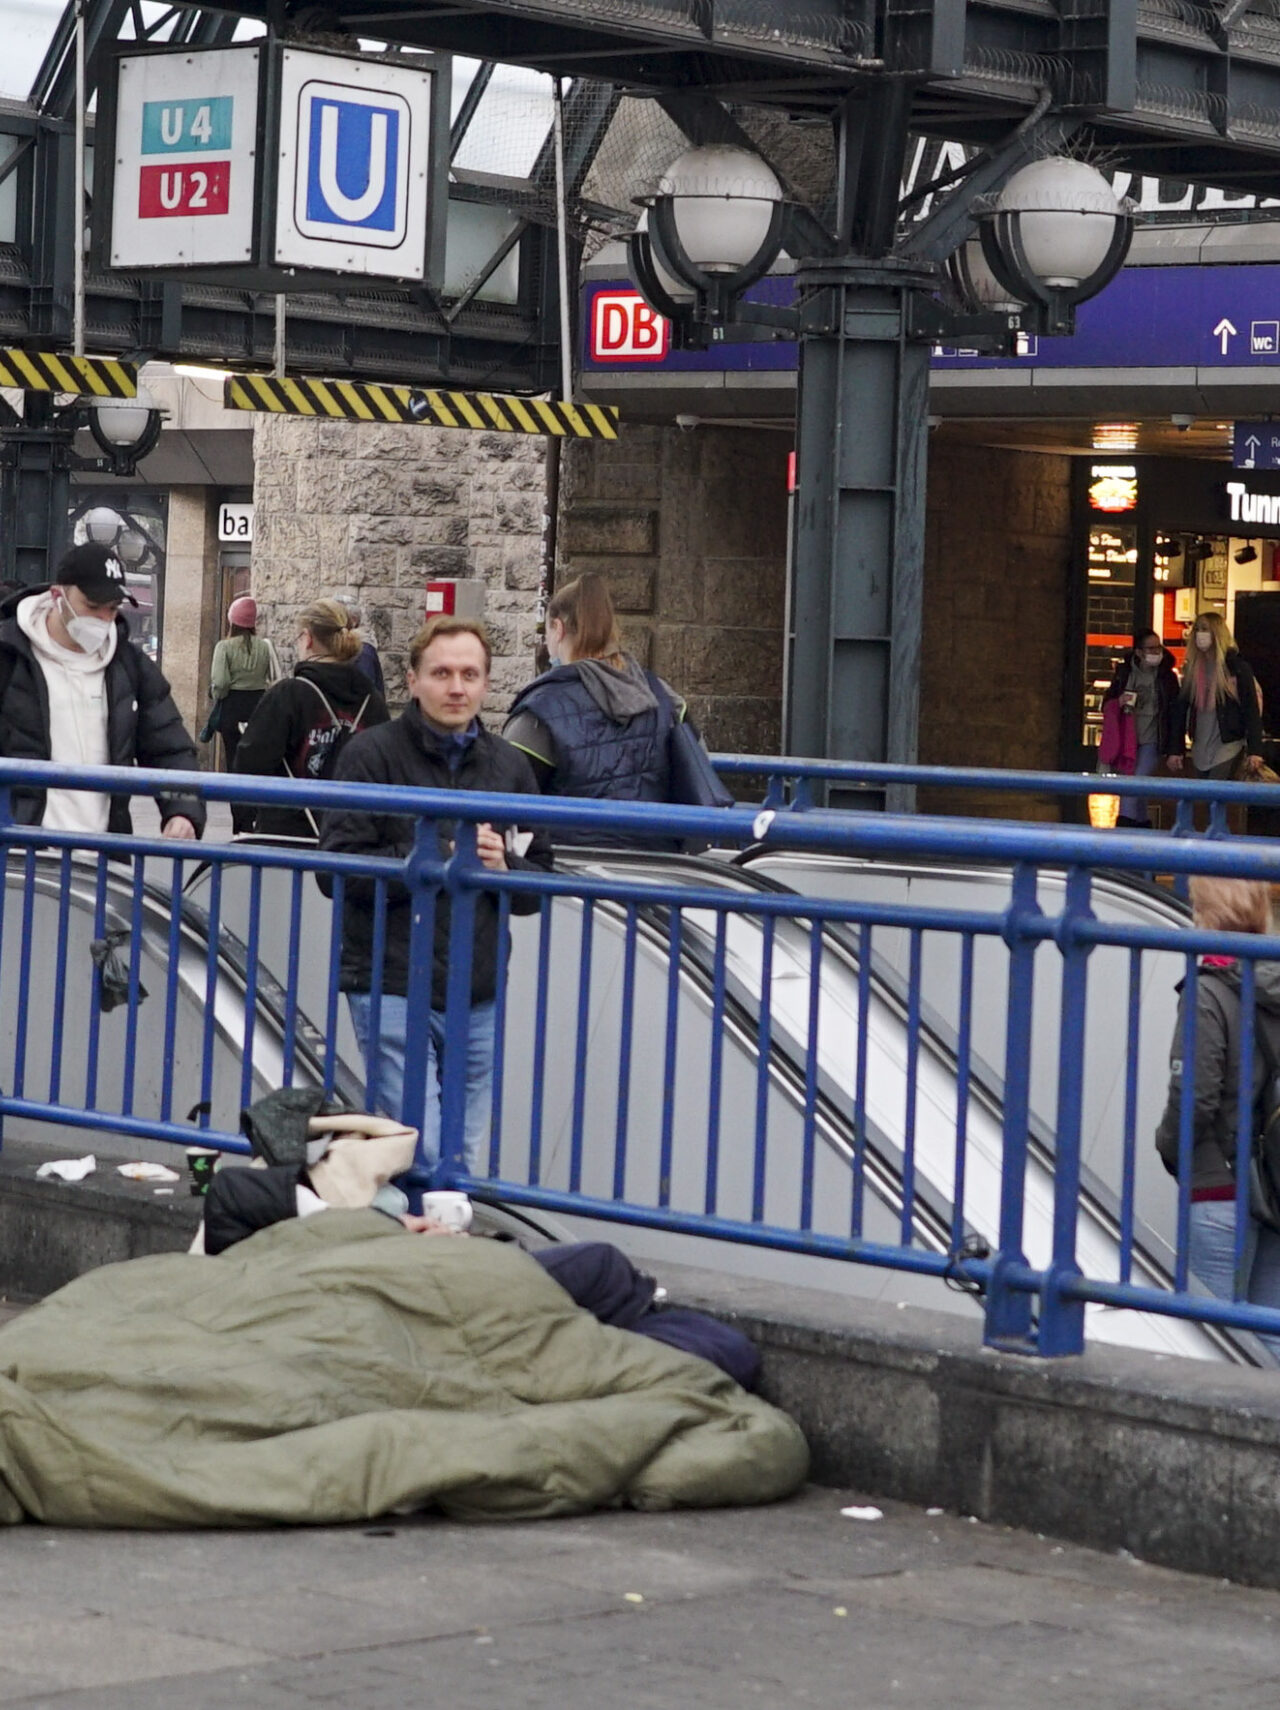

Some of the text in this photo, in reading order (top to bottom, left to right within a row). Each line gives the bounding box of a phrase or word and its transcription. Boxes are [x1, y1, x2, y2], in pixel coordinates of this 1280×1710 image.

[161, 105, 212, 145] U4
[320, 105, 388, 221] U
[160, 171, 208, 209] U2
[601, 303, 658, 349] DB
[1008, 316, 1020, 329] 63
[1253, 337, 1273, 350] WC
[223, 508, 249, 535] ba
